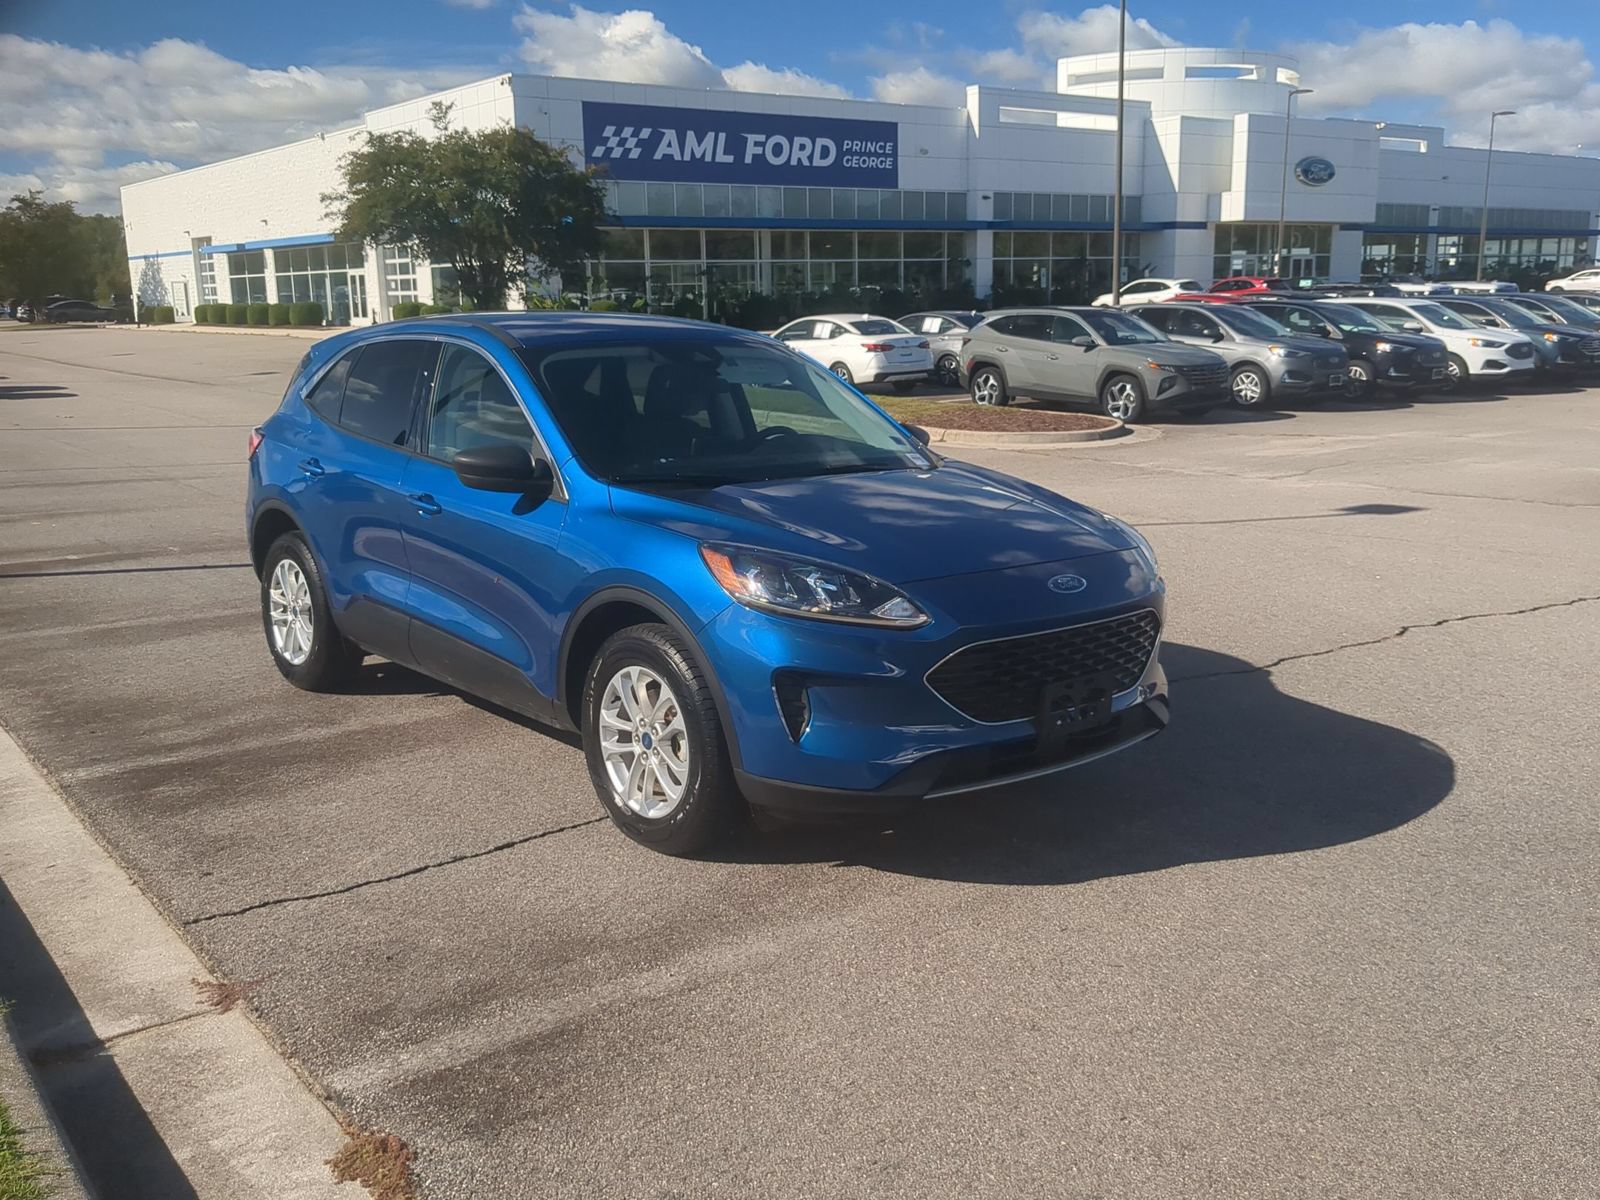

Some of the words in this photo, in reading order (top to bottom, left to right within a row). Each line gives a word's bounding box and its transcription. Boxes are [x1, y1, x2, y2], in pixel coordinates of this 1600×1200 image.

[653, 128, 735, 163] AML
[740, 133, 837, 167] FORD
[843, 140, 894, 154] PRINCE
[842, 156, 894, 169] GEORGE
